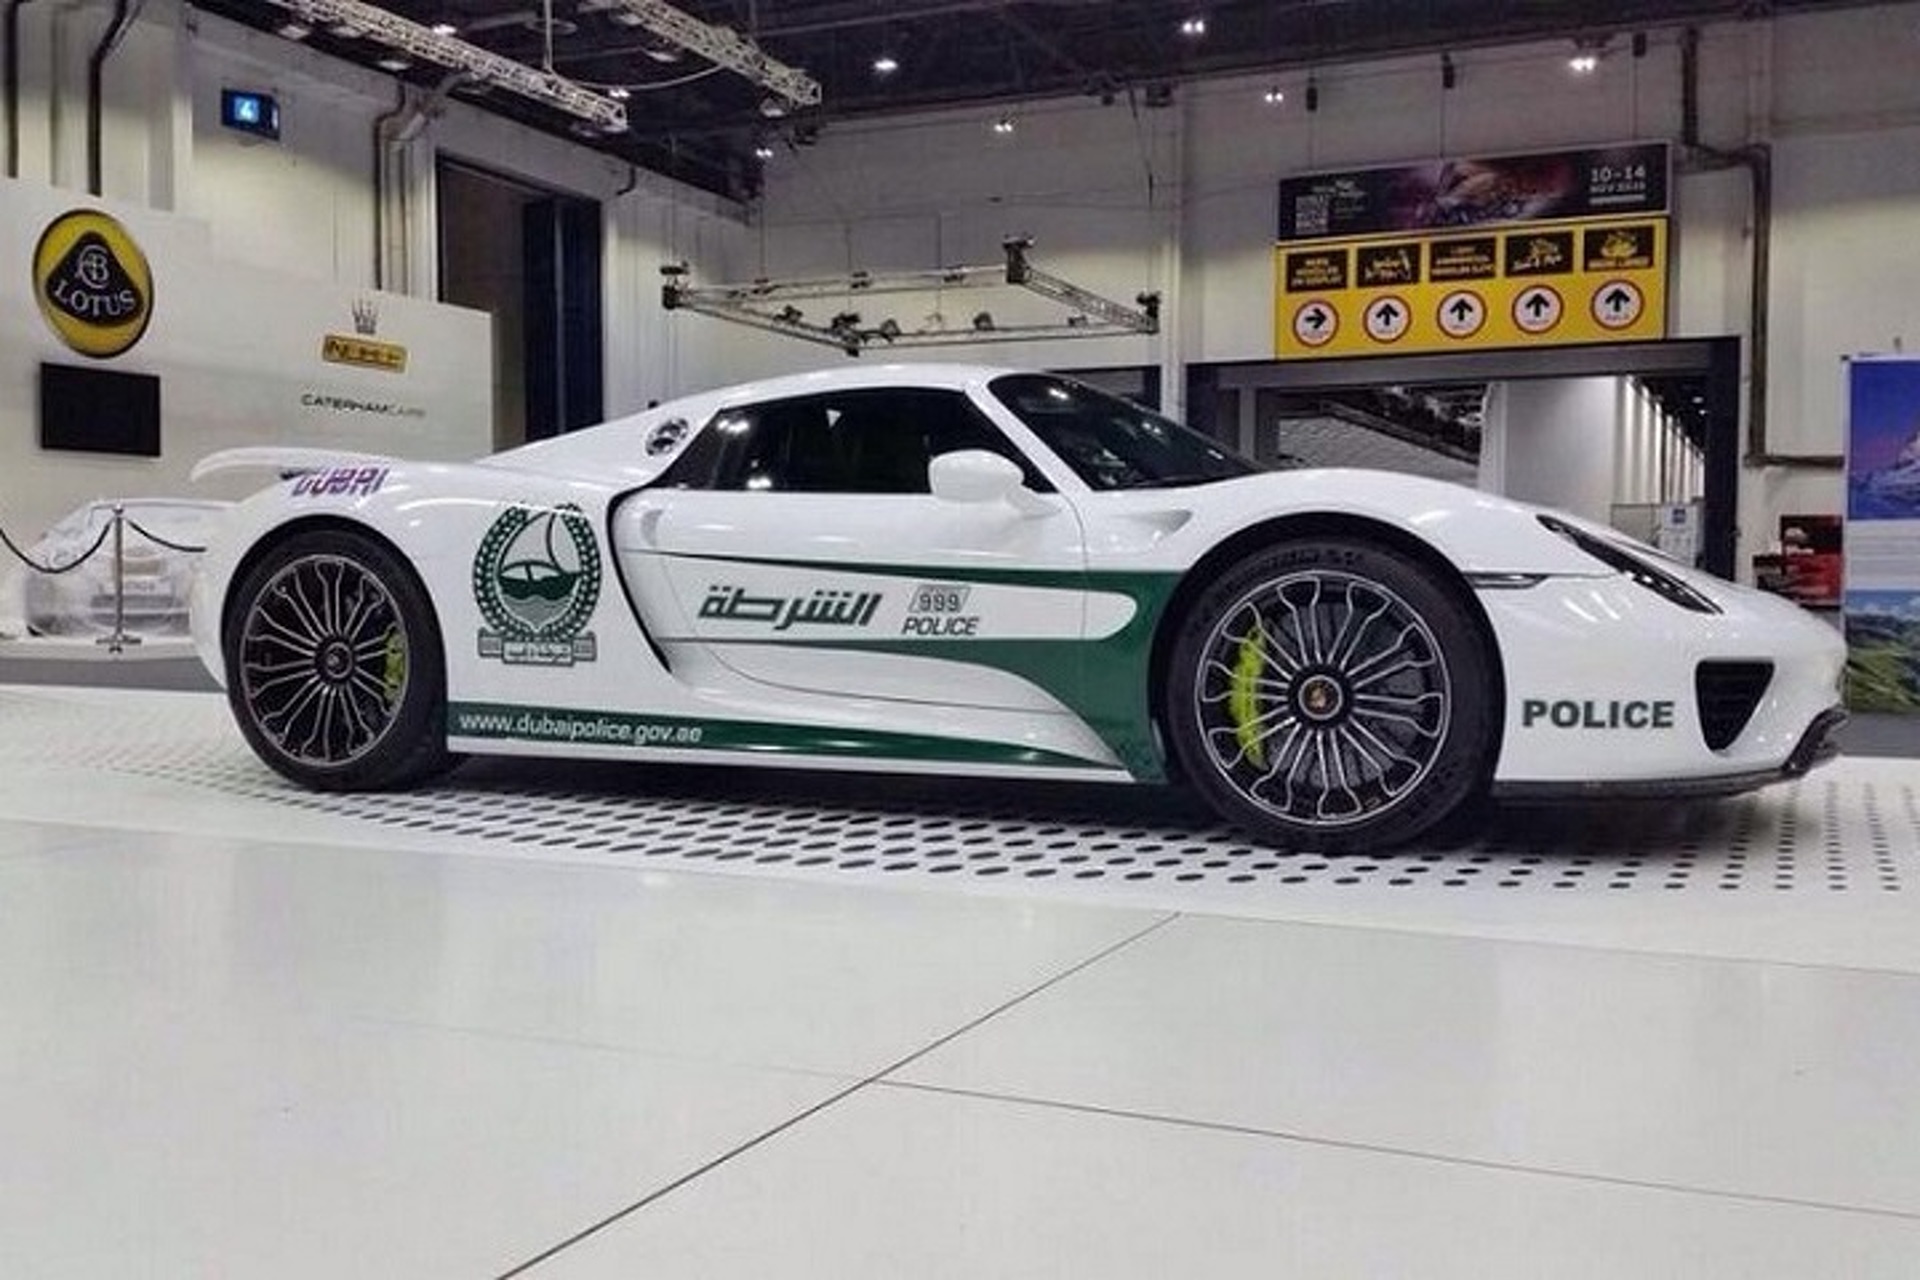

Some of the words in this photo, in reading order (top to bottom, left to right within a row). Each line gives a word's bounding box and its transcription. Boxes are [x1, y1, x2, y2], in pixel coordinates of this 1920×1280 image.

[240, 100, 253, 120] 4
[1591, 166, 1611, 182] 10
[1624, 164, 1646, 180] 14
[53, 279, 136, 316] LOTUS
[291, 468, 390, 497] DUBAI
[699, 585, 882, 630] الشرطة
[919, 593, 961, 612] 999
[902, 617, 979, 635] POLICE
[458, 713, 703, 745] www.dubaipolice.gov.ae
[1522, 700, 1675, 729] POLICE
